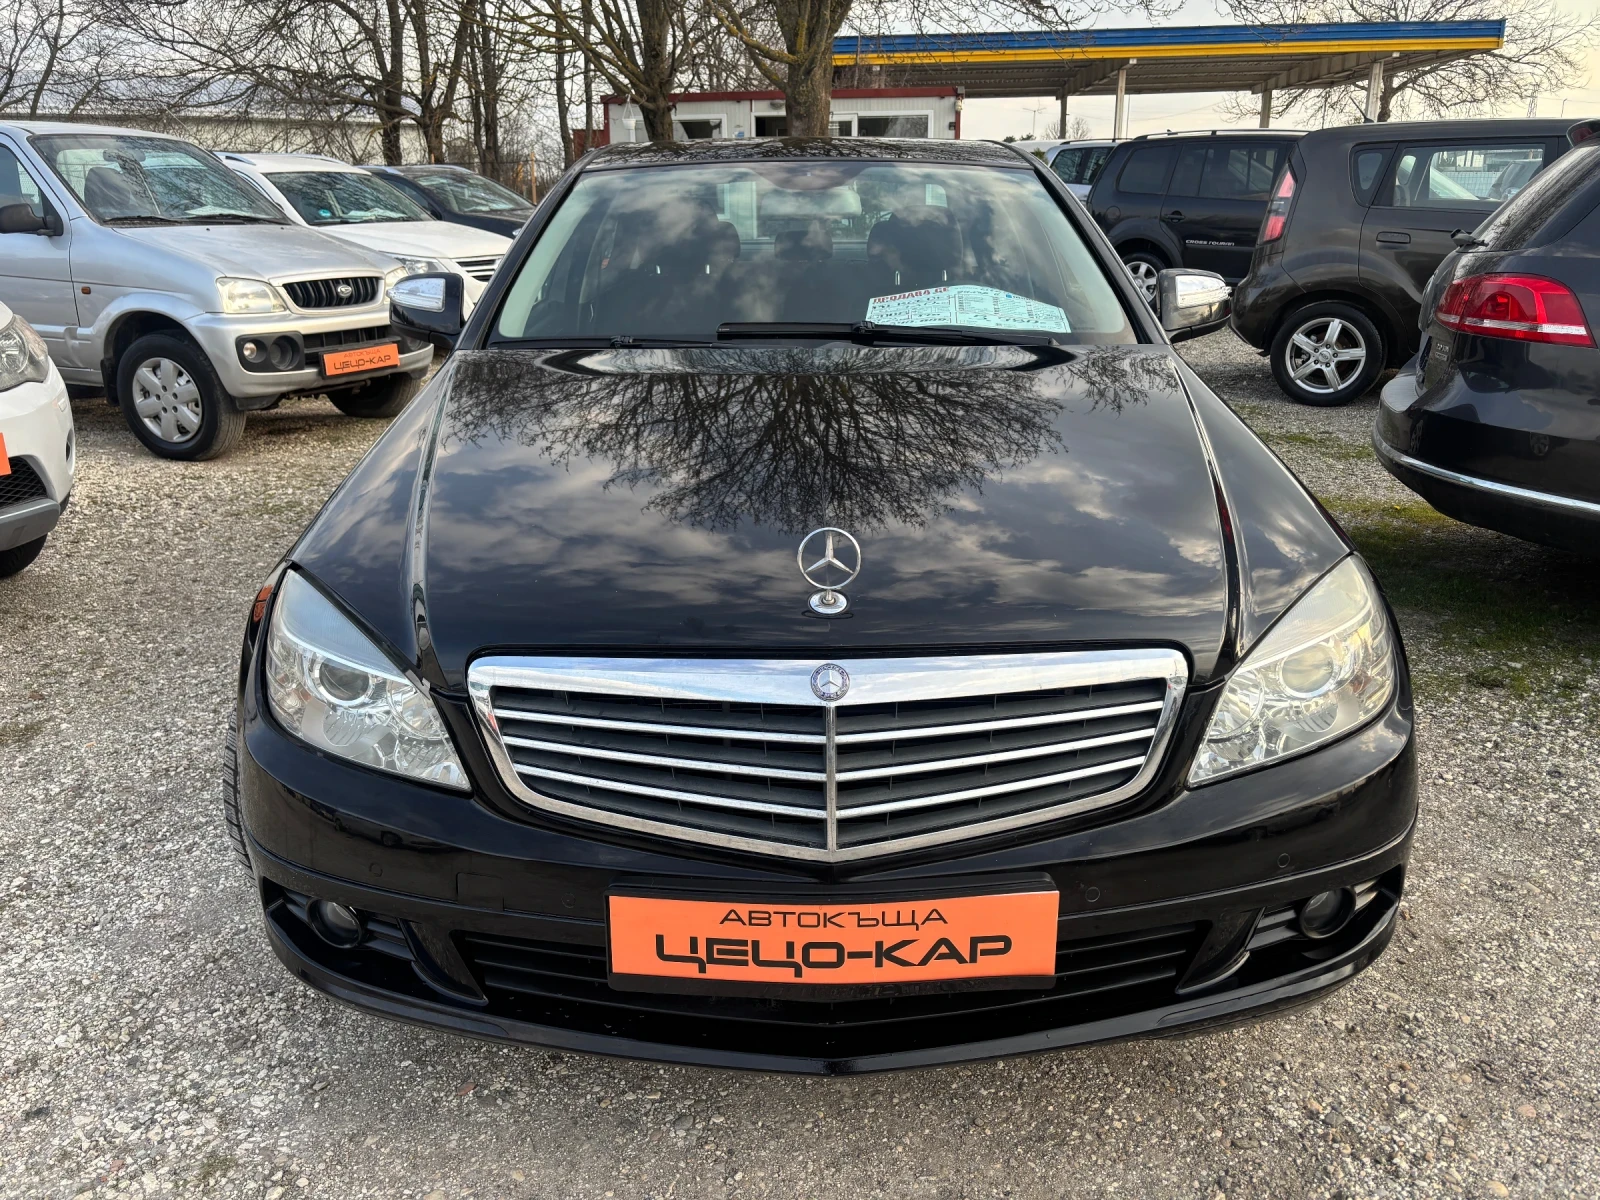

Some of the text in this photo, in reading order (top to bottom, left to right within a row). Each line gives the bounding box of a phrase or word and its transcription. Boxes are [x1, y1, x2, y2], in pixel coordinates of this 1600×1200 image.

[333, 354, 392, 371] ЦЕЦО-КАР
[343, 349, 381, 359] АВТОКЪЩА
[719, 908, 949, 932] АВТОКЪЩА
[655, 934, 1013, 979] ЦЕЦО-КАР
